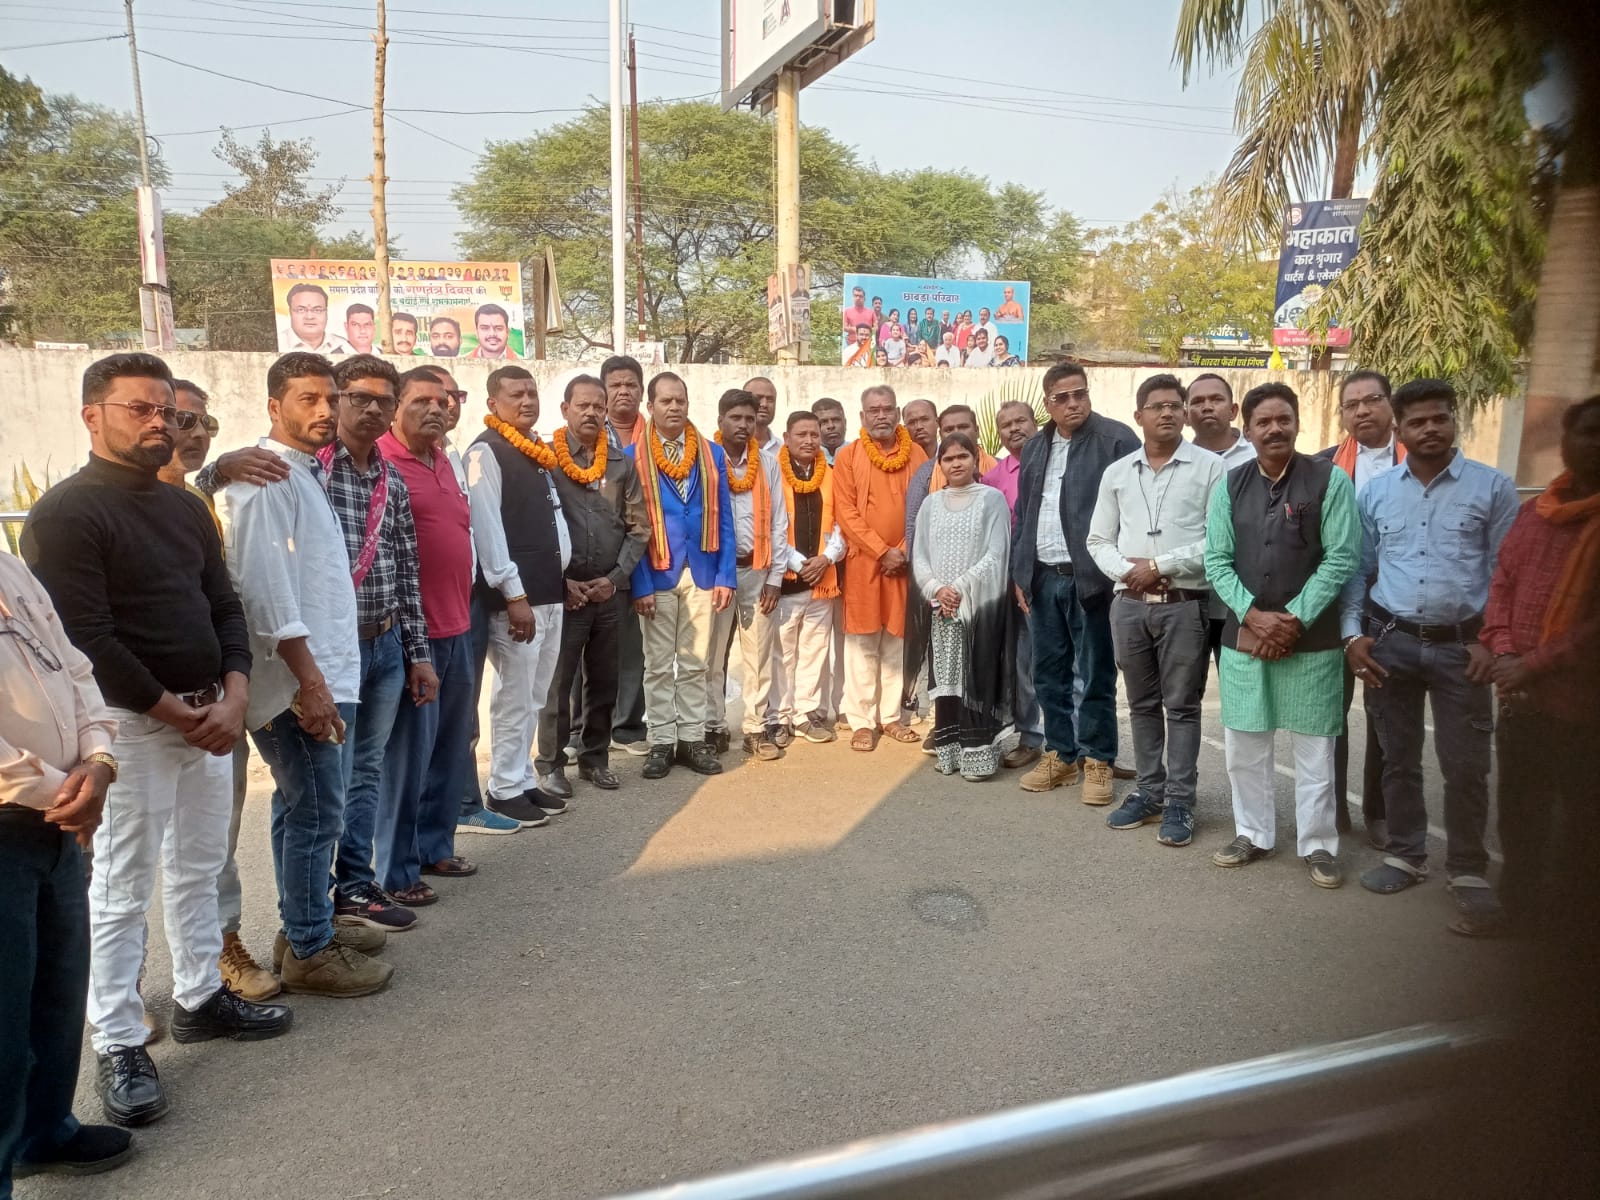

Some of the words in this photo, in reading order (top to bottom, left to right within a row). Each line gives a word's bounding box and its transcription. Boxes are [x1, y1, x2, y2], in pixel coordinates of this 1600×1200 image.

[1307, 270, 1315, 281] &
[405, 283, 442, 295] गणतंत्र
[445, 283, 473, 295] दिवस
